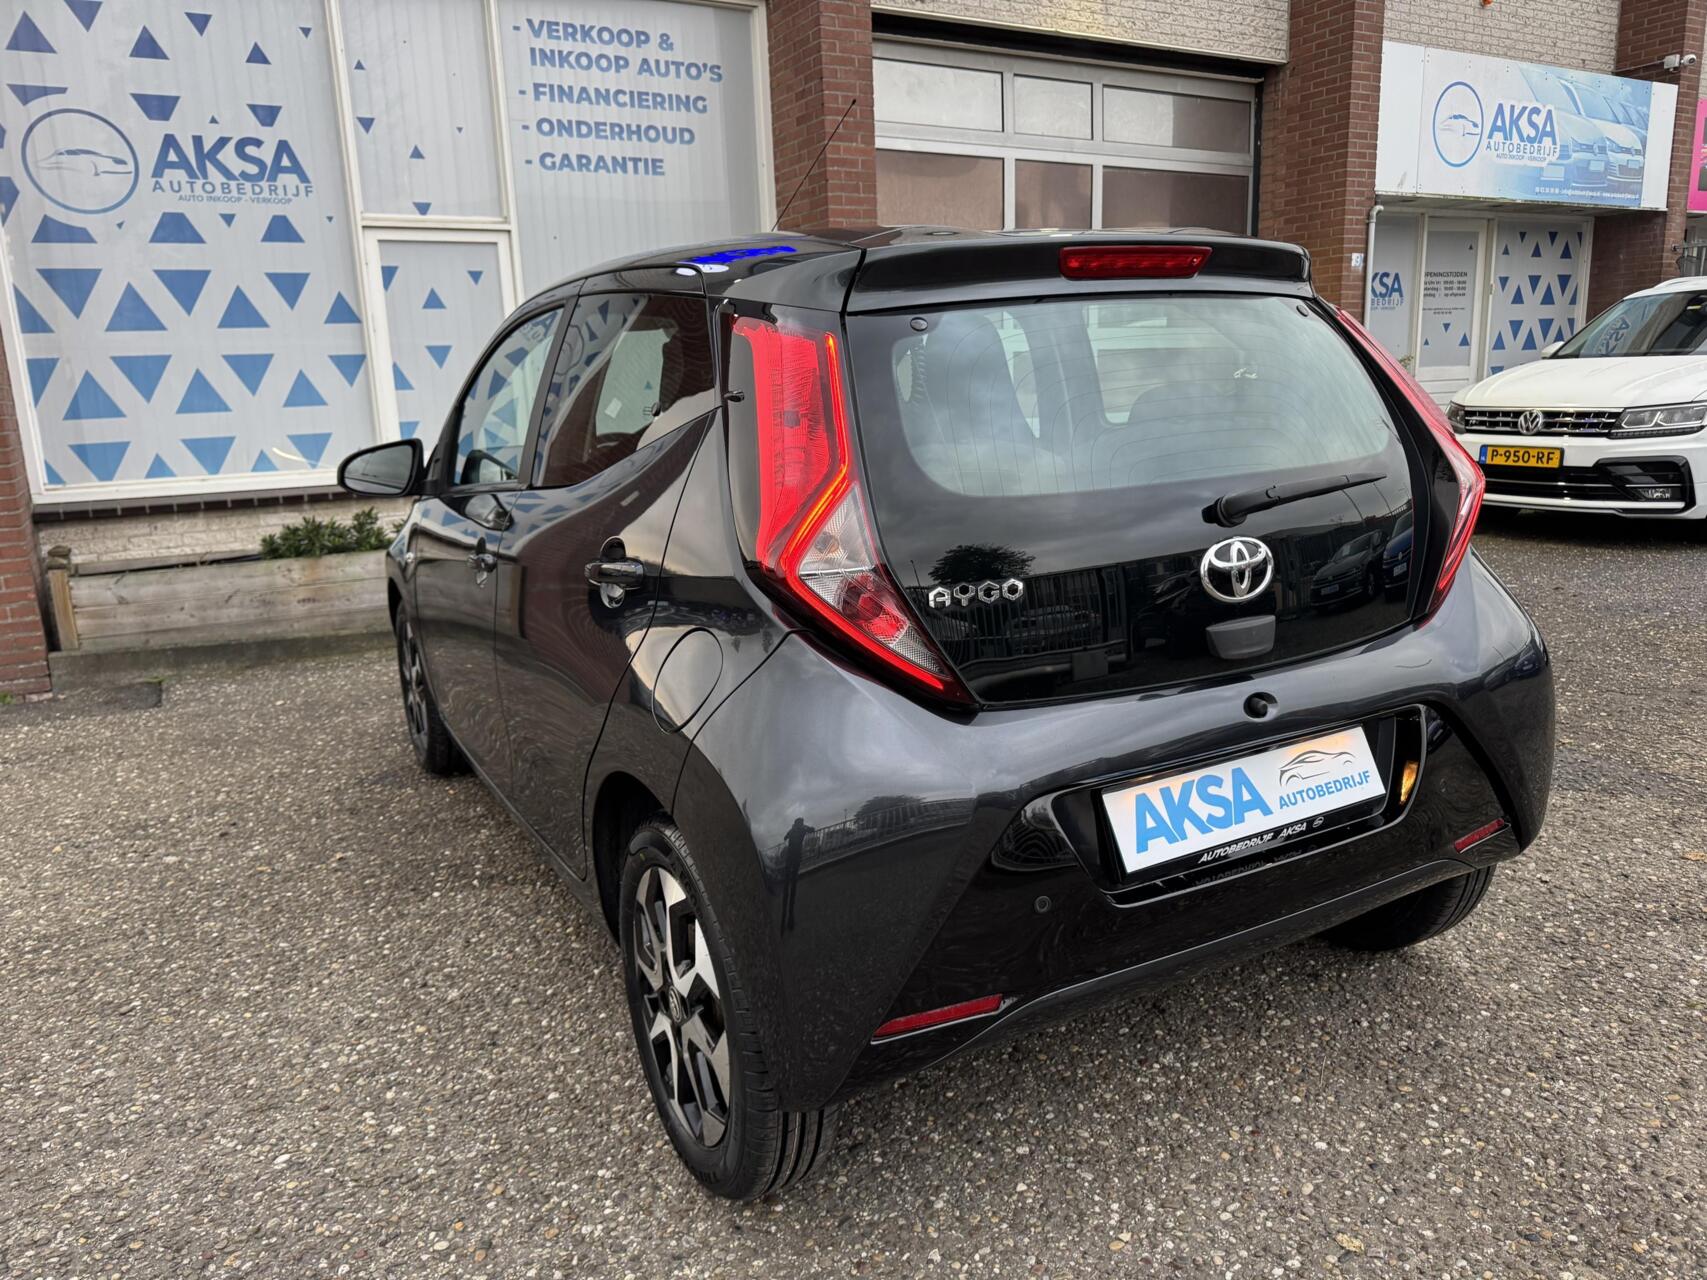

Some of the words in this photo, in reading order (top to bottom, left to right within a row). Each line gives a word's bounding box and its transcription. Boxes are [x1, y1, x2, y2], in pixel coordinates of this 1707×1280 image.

[526, 18, 650, 48] VERKOOP
[658, 33, 674, 51] &
[529, 47, 630, 74] INKOOP
[637, 57, 723, 83] AUTO'S
[533, 82, 708, 114] FINANCIERING
[536, 117, 695, 145] ONDERHOUD
[1487, 102, 1557, 146] AKSA
[151, 133, 312, 184] AKSA
[539, 152, 665, 176] GARANTIE
[1485, 141, 1558, 157] AUTOBEDRIJF
[152, 180, 314, 198] AUTOBEDRIJF
[178, 194, 204, 203] AUTO
[206, 195, 243, 204] INKOOP
[251, 197, 293, 206] VERKOOP
[1491, 448, 1555, 465] P-950-RF
[928, 578, 1024, 609] AYGO
[1279, 769, 1371, 810] AUTOBEDRIJF
[1135, 767, 1273, 854] AKSA
[1198, 832, 1274, 864] AUTOBEDRIJF
[1277, 822, 1307, 840] AKSA
